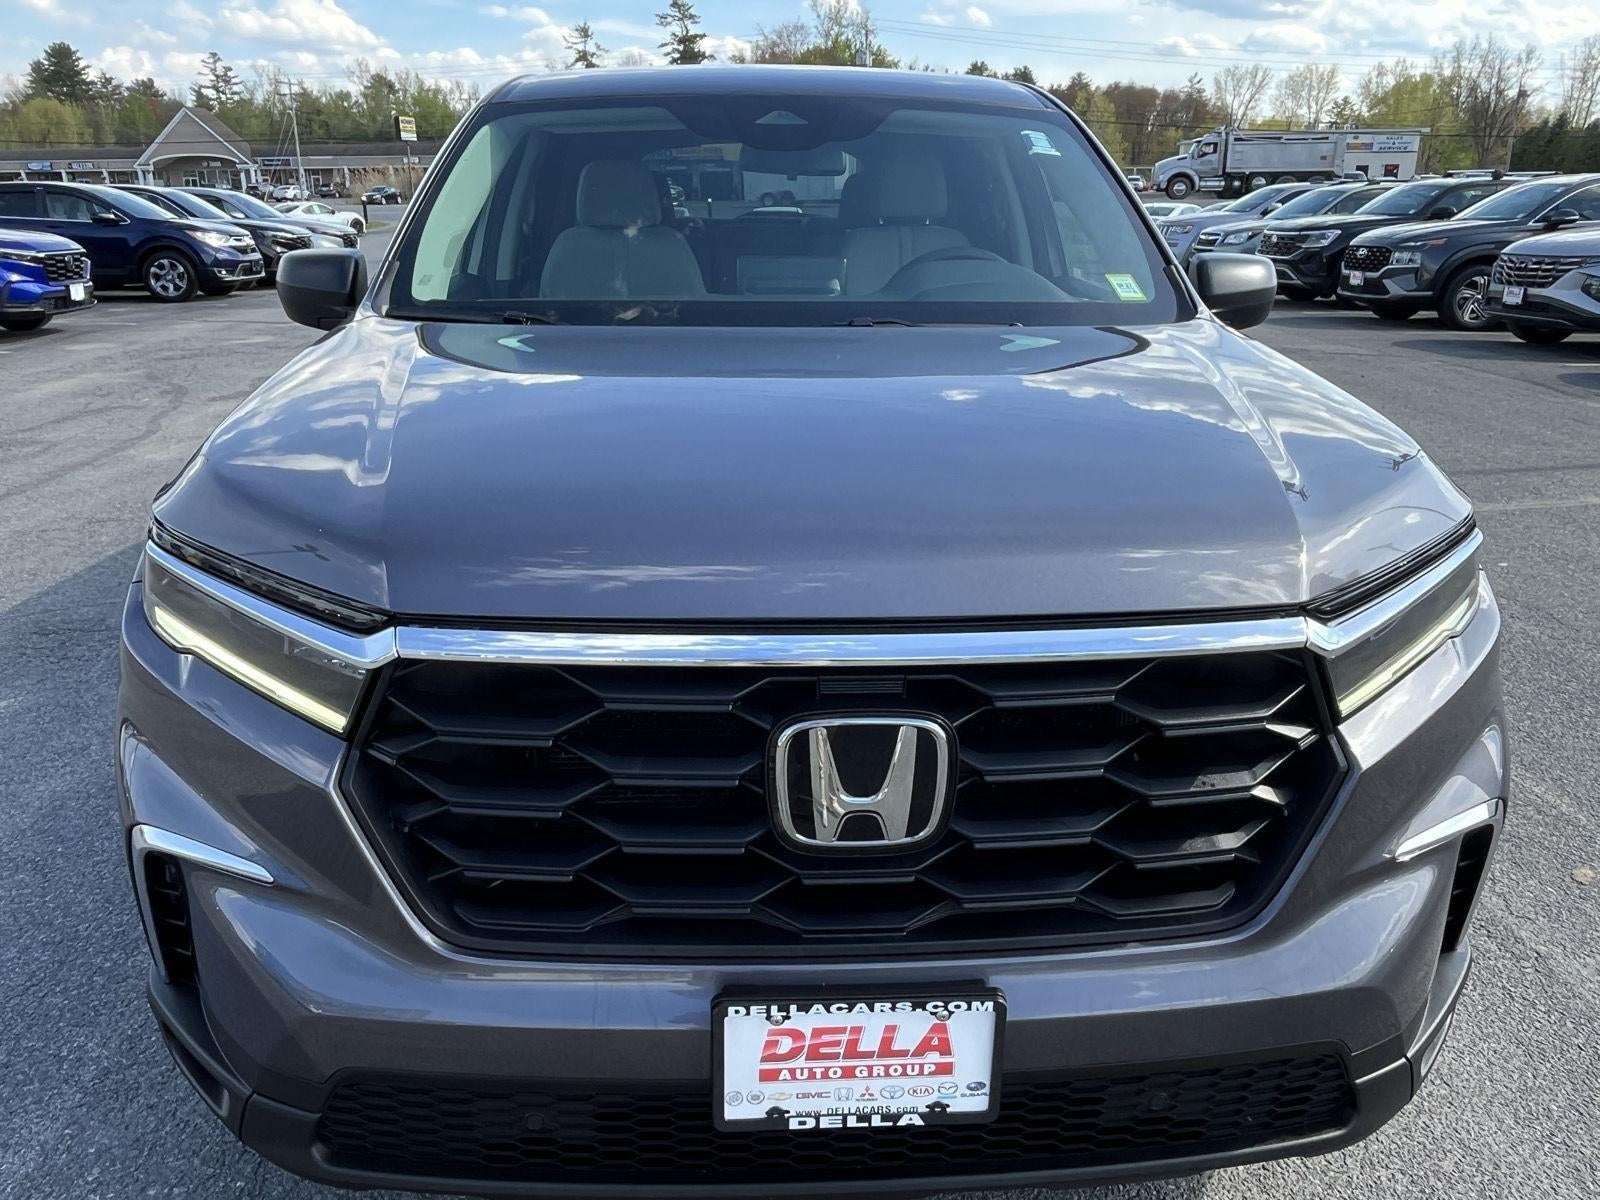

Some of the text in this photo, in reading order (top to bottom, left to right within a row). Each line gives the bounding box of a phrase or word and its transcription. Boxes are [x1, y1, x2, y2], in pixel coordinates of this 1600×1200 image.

[727, 1001, 994, 1017] DELLACARS.COM
[760, 1022, 954, 1064] DELLA
[778, 1063, 936, 1081] AUTO GROUP
[796, 1091, 831, 1099] GMC
[795, 1105, 919, 1116] wwwDELLACARS.com
[789, 1113, 925, 1130] DELLA
